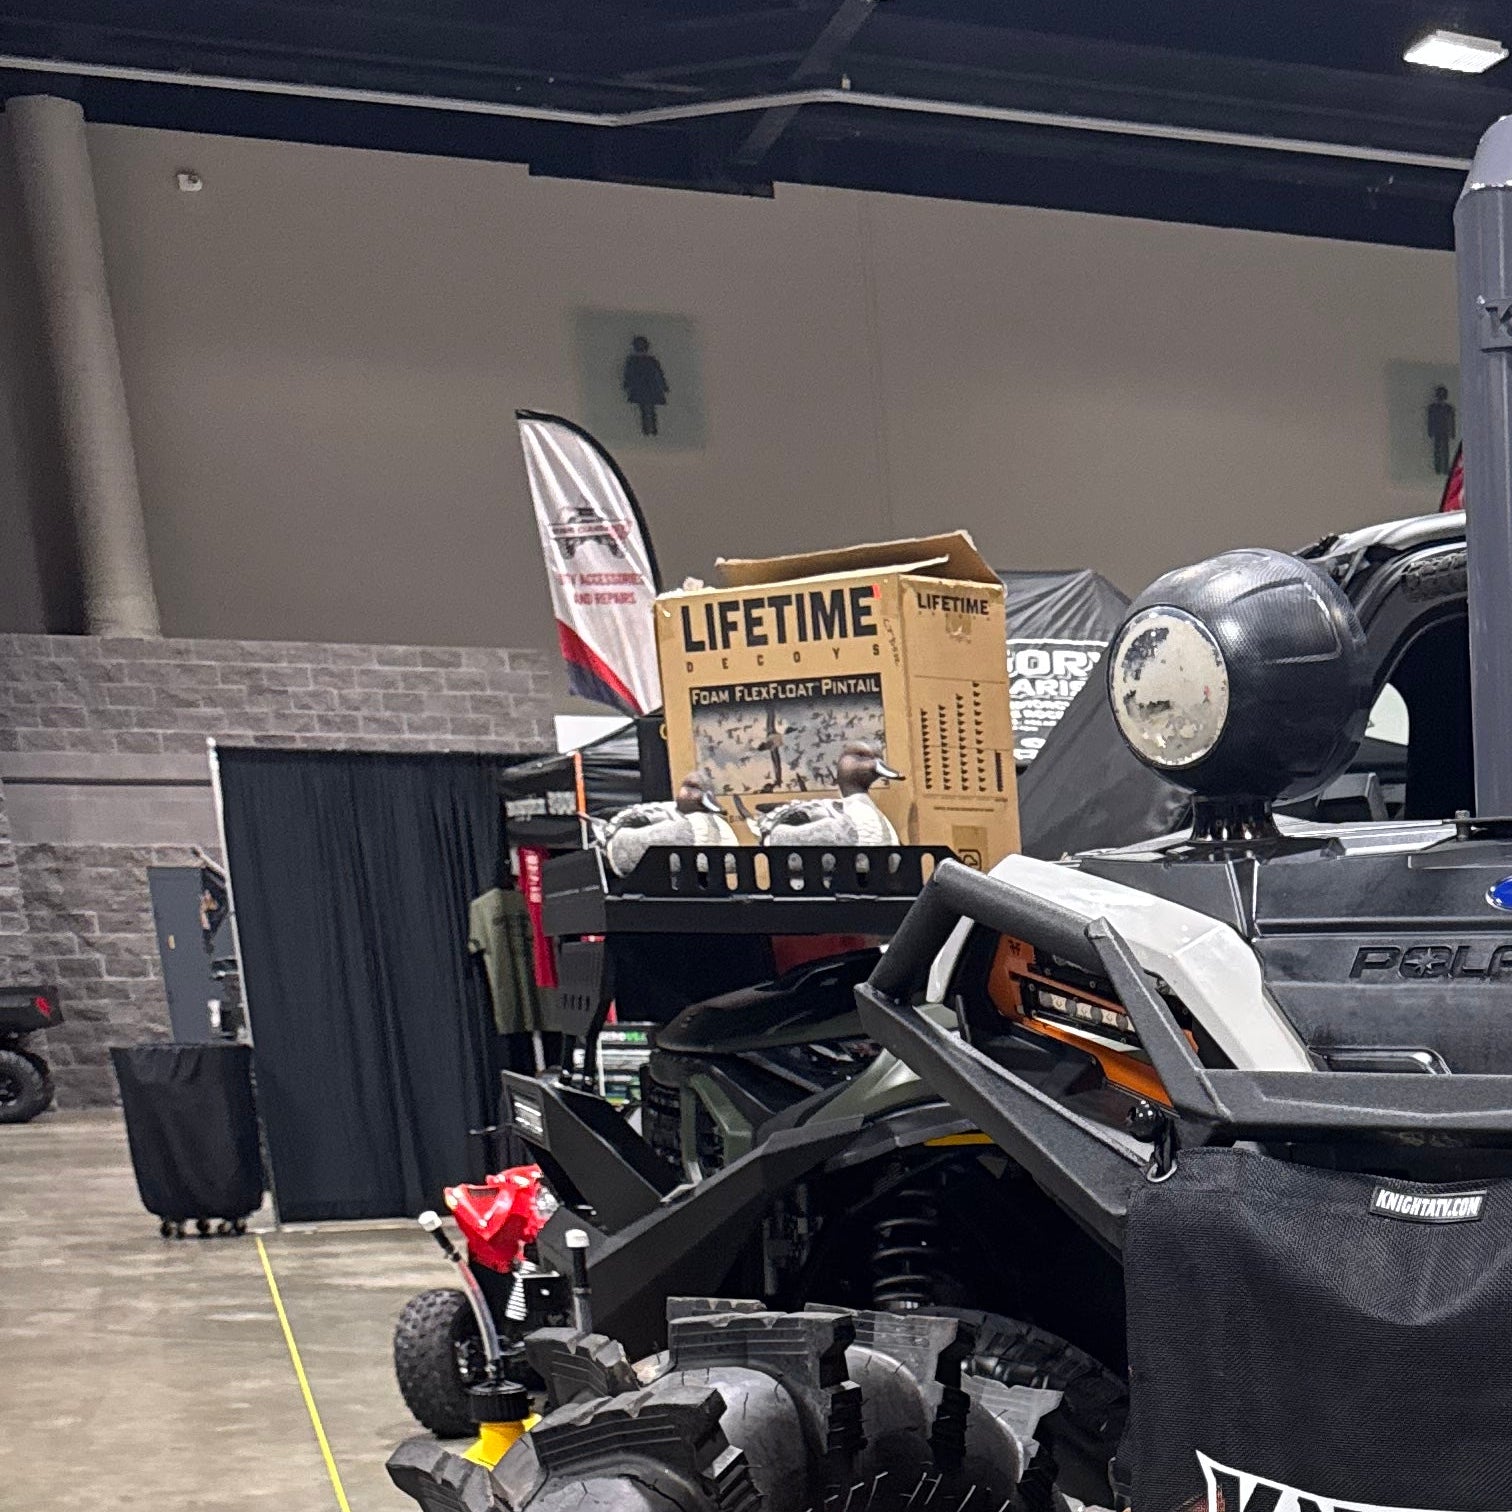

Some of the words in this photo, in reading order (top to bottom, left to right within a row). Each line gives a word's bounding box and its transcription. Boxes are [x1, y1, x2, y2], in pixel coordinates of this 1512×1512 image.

[916, 592, 990, 616] LIFETIME
[681, 585, 878, 653] LIFETIME
[691, 689, 730, 706] FOAM
[821, 677, 880, 696] PINTAIL
[1375, 1188, 1483, 1218] KNIGHTATV.COM
